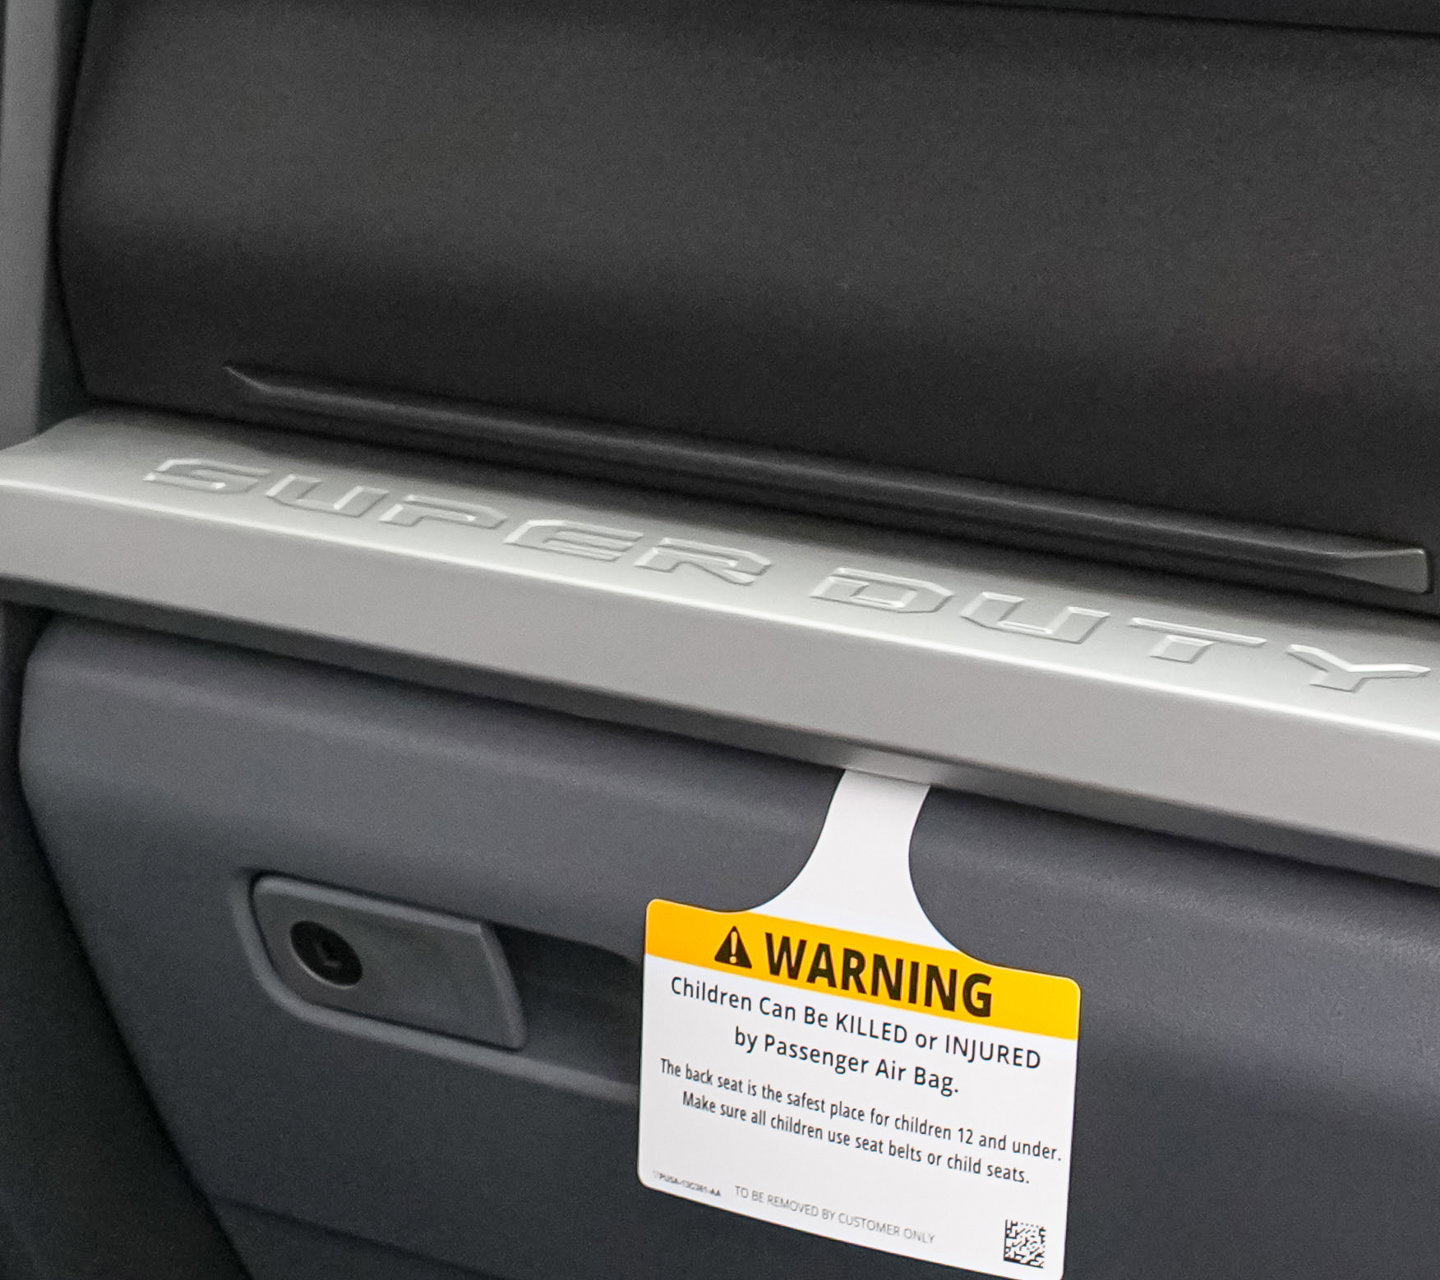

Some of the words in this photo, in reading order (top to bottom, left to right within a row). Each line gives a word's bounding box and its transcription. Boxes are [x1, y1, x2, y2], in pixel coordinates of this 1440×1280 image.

[142, 455, 773, 585] SUPER
[809, 565, 1432, 694] DUTY
[765, 932, 993, 1018] WARNING
[671, 976, 752, 1011] Children
[759, 997, 796, 1021] Can
[804, 1006, 828, 1028] Be
[836, 1012, 907, 1044] KILLED
[915, 1033, 938, 1050] or
[945, 1034, 1041, 1069] INJURED
[735, 1026, 758, 1053] by
[765, 1034, 869, 1074] Passenger
[875, 1058, 907, 1081] Air
[914, 1066, 959, 1097] Bag.
[660, 1057, 681, 1077] The
[686, 1063, 713, 1085] back
[717, 1074, 743, 1094] seat
[747, 1079, 757, 1096] is
[762, 1084, 782, 1103] the
[787, 1092, 825, 1113] safest
[830, 1101, 865, 1122] place
[870, 1107, 889, 1126] for
[894, 1114, 952, 1140] children
[958, 1128, 974, 1145] 12
[979, 1134, 1007, 1151] and
[1012, 1140, 1061, 1162] under.
[682, 1090, 716, 1113] Make
[720, 1102, 747, 1121] sure
[751, 1109, 766, 1126] all
[770, 1114, 823, 1140] children
[828, 1128, 850, 1147] use
[855, 1135, 884, 1154] seat
[889, 1140, 922, 1162] belts
[927, 1151, 942, 1167] or
[947, 1153, 982, 1174] child
[987, 1164, 1030, 1184] seats.
[734, 1185, 749, 1199] TO
[752, 1189, 765, 1204] BE
[767, 1194, 819, 1217] REMOVED
[822, 1207, 836, 1221] BY
[838, 1212, 900, 1237] CUSTOMER
[903, 1228, 935, 1245] ONLY
